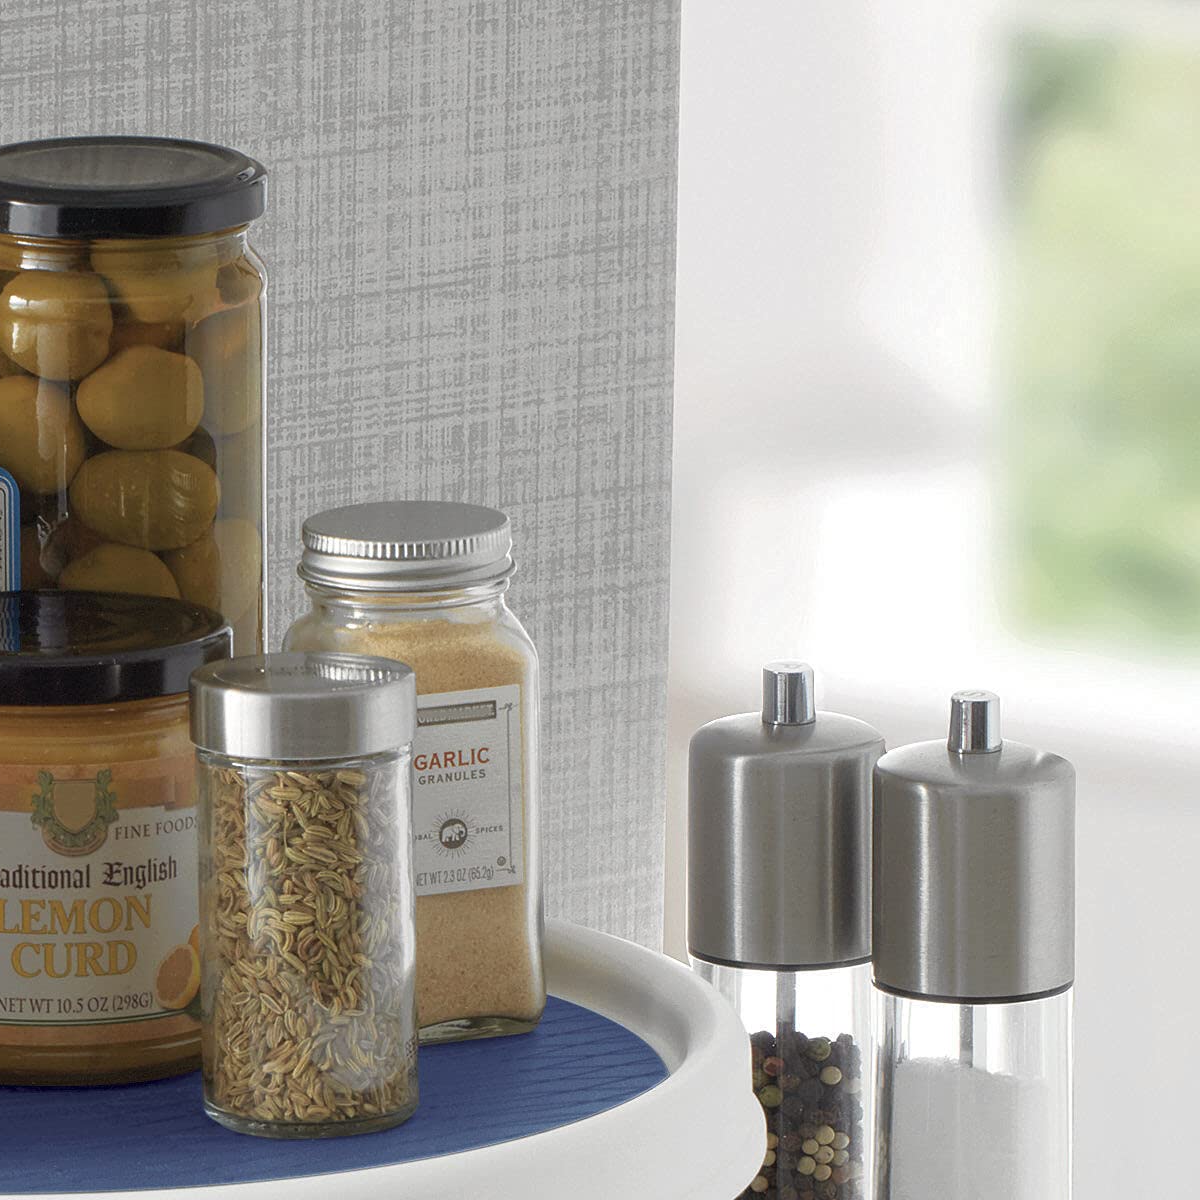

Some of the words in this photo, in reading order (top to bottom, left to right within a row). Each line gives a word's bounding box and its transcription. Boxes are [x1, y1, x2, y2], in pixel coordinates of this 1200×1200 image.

[414, 747, 490, 771] GARLIC
[418, 768, 487, 786] GRANULES
[114, 825, 151, 841] FINE
[476, 825, 504, 834] SPICES
[101, 855, 178, 890] English
[429, 871, 442, 885] WT
[456, 868, 466, 882] OZ
[10, 939, 138, 980] CURD
[29, 999, 53, 1014] WT
[57, 998, 83, 1014] 10.5
[86, 997, 109, 1013] OZ
[112, 991, 153, 1013] (298G)
